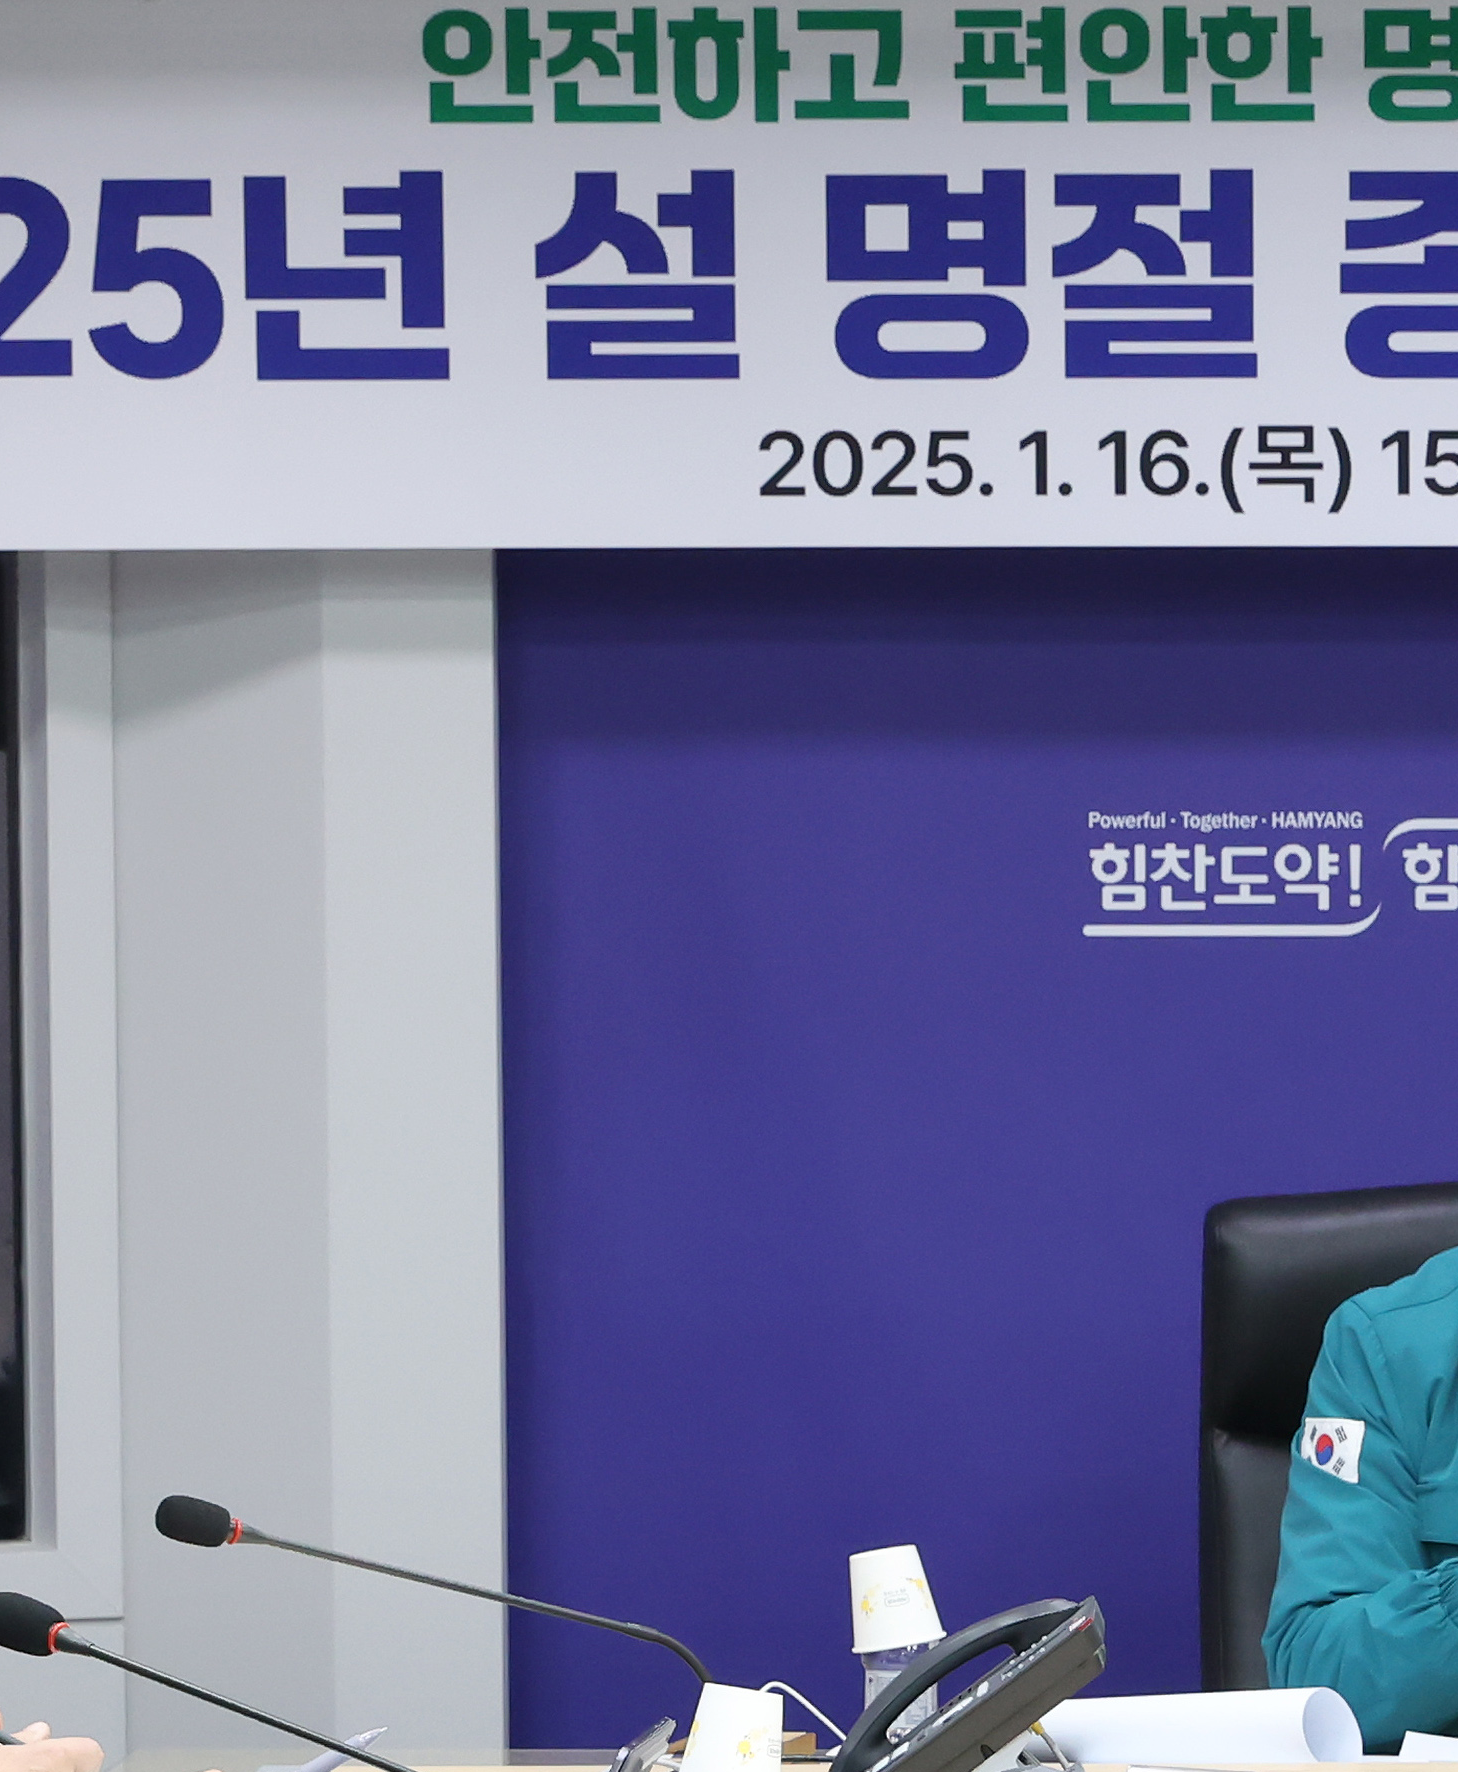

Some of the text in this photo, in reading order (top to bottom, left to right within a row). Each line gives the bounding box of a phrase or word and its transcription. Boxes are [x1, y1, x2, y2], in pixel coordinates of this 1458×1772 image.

[422, 6, 910, 124] 안전하고
[954, 5, 1324, 123] 편안한
[534, 169, 740, 380] 설
[825, 168, 1258, 380] 명절
[759, 430, 994, 497] 2025.
[1019, 430, 1073, 497] 1.
[1098, 425, 1352, 514] 16.(목)
[1088, 811, 1363, 833] Powerful Together HAMYANG
[1089, 842, 1363, 912] 힘찬도약!
